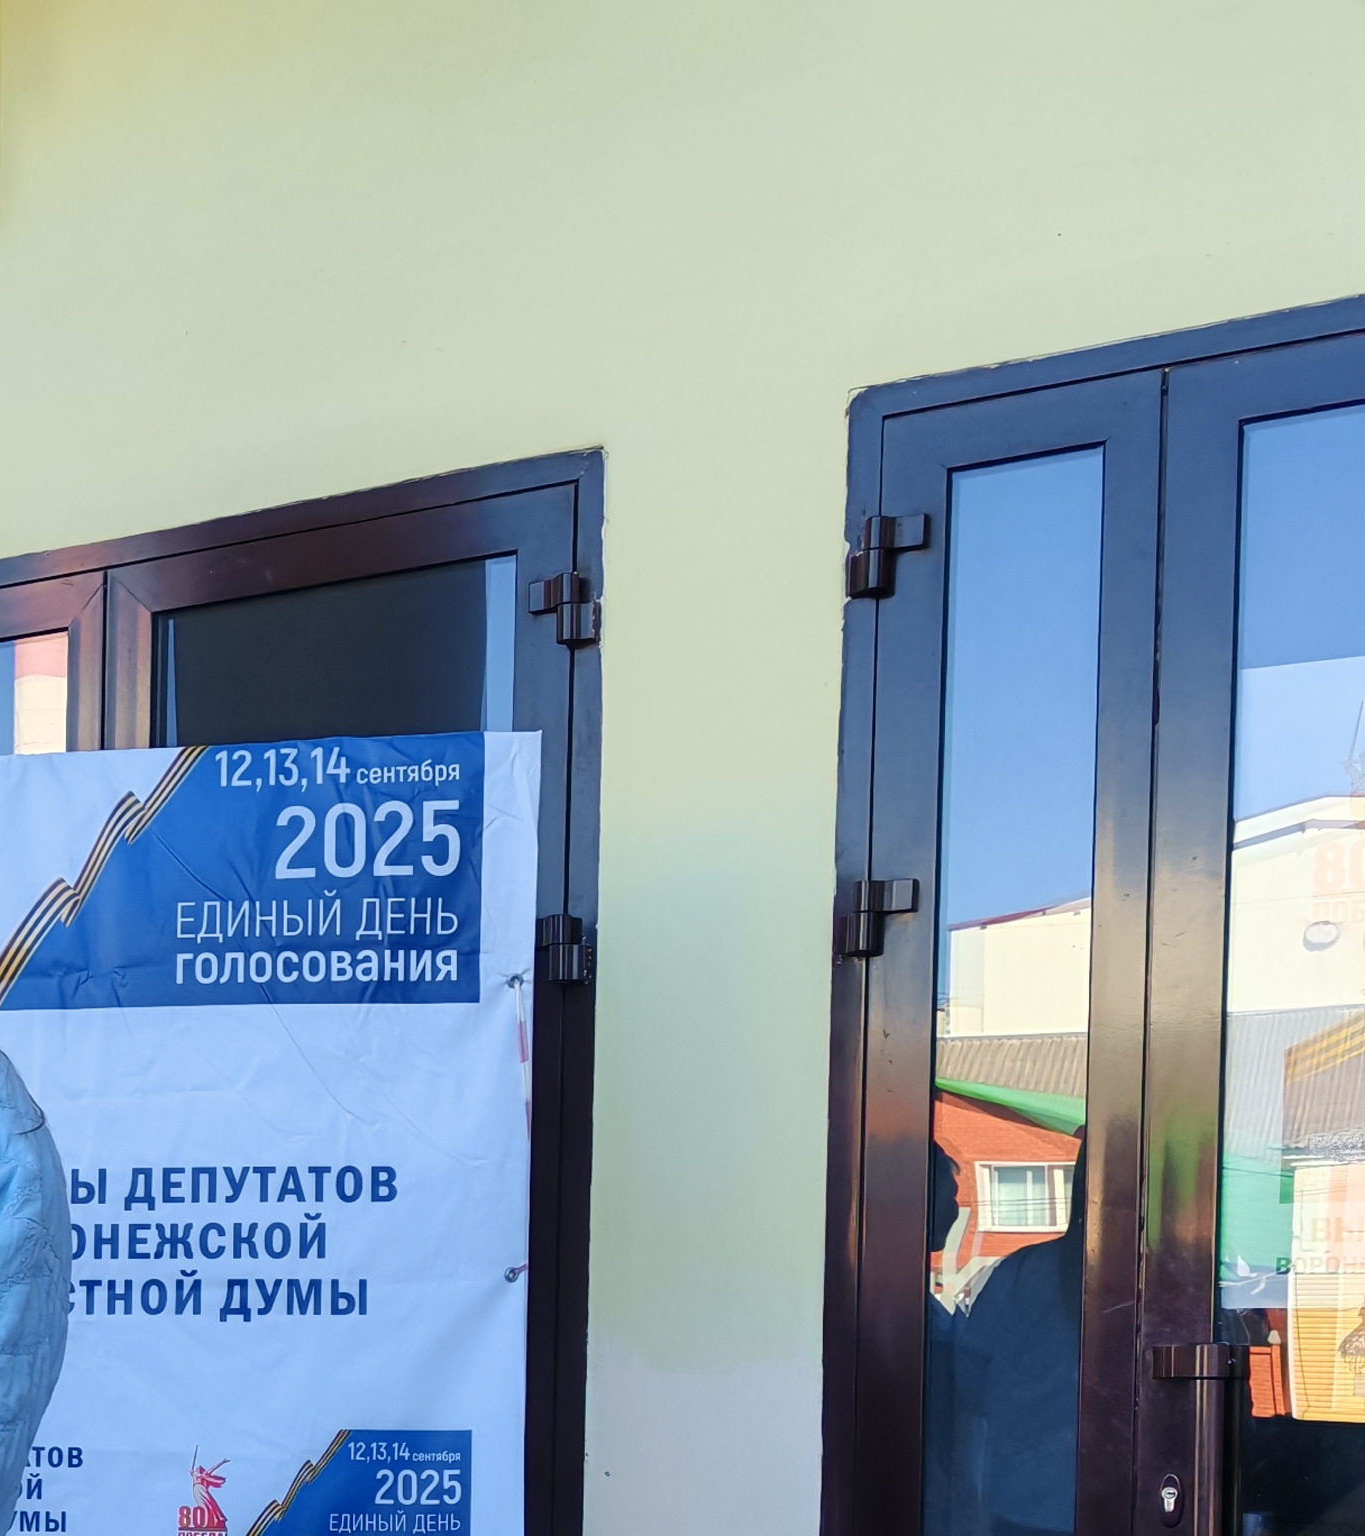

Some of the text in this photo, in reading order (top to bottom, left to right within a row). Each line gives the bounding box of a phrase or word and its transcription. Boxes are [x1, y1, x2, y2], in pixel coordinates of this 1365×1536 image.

[214, 747, 461, 793] 12,13,14 сентября
[274, 799, 462, 880] 2025
[175, 888, 459, 944] ЕДИНЫЙ ДЕНЬ
[175, 948, 459, 985] голосования
[123, 1165, 398, 1212] ДЕПУТАТОВ
[218, 1278, 368, 1323] ДУМЫ
[347, 1441, 462, 1463] 12,13,14 сентября
[373, 1469, 463, 1506] 2025
[178, 1505, 206, 1528] 80
[328, 1510, 462, 1535] ЕДИНЫЙ ДЕНЬ
